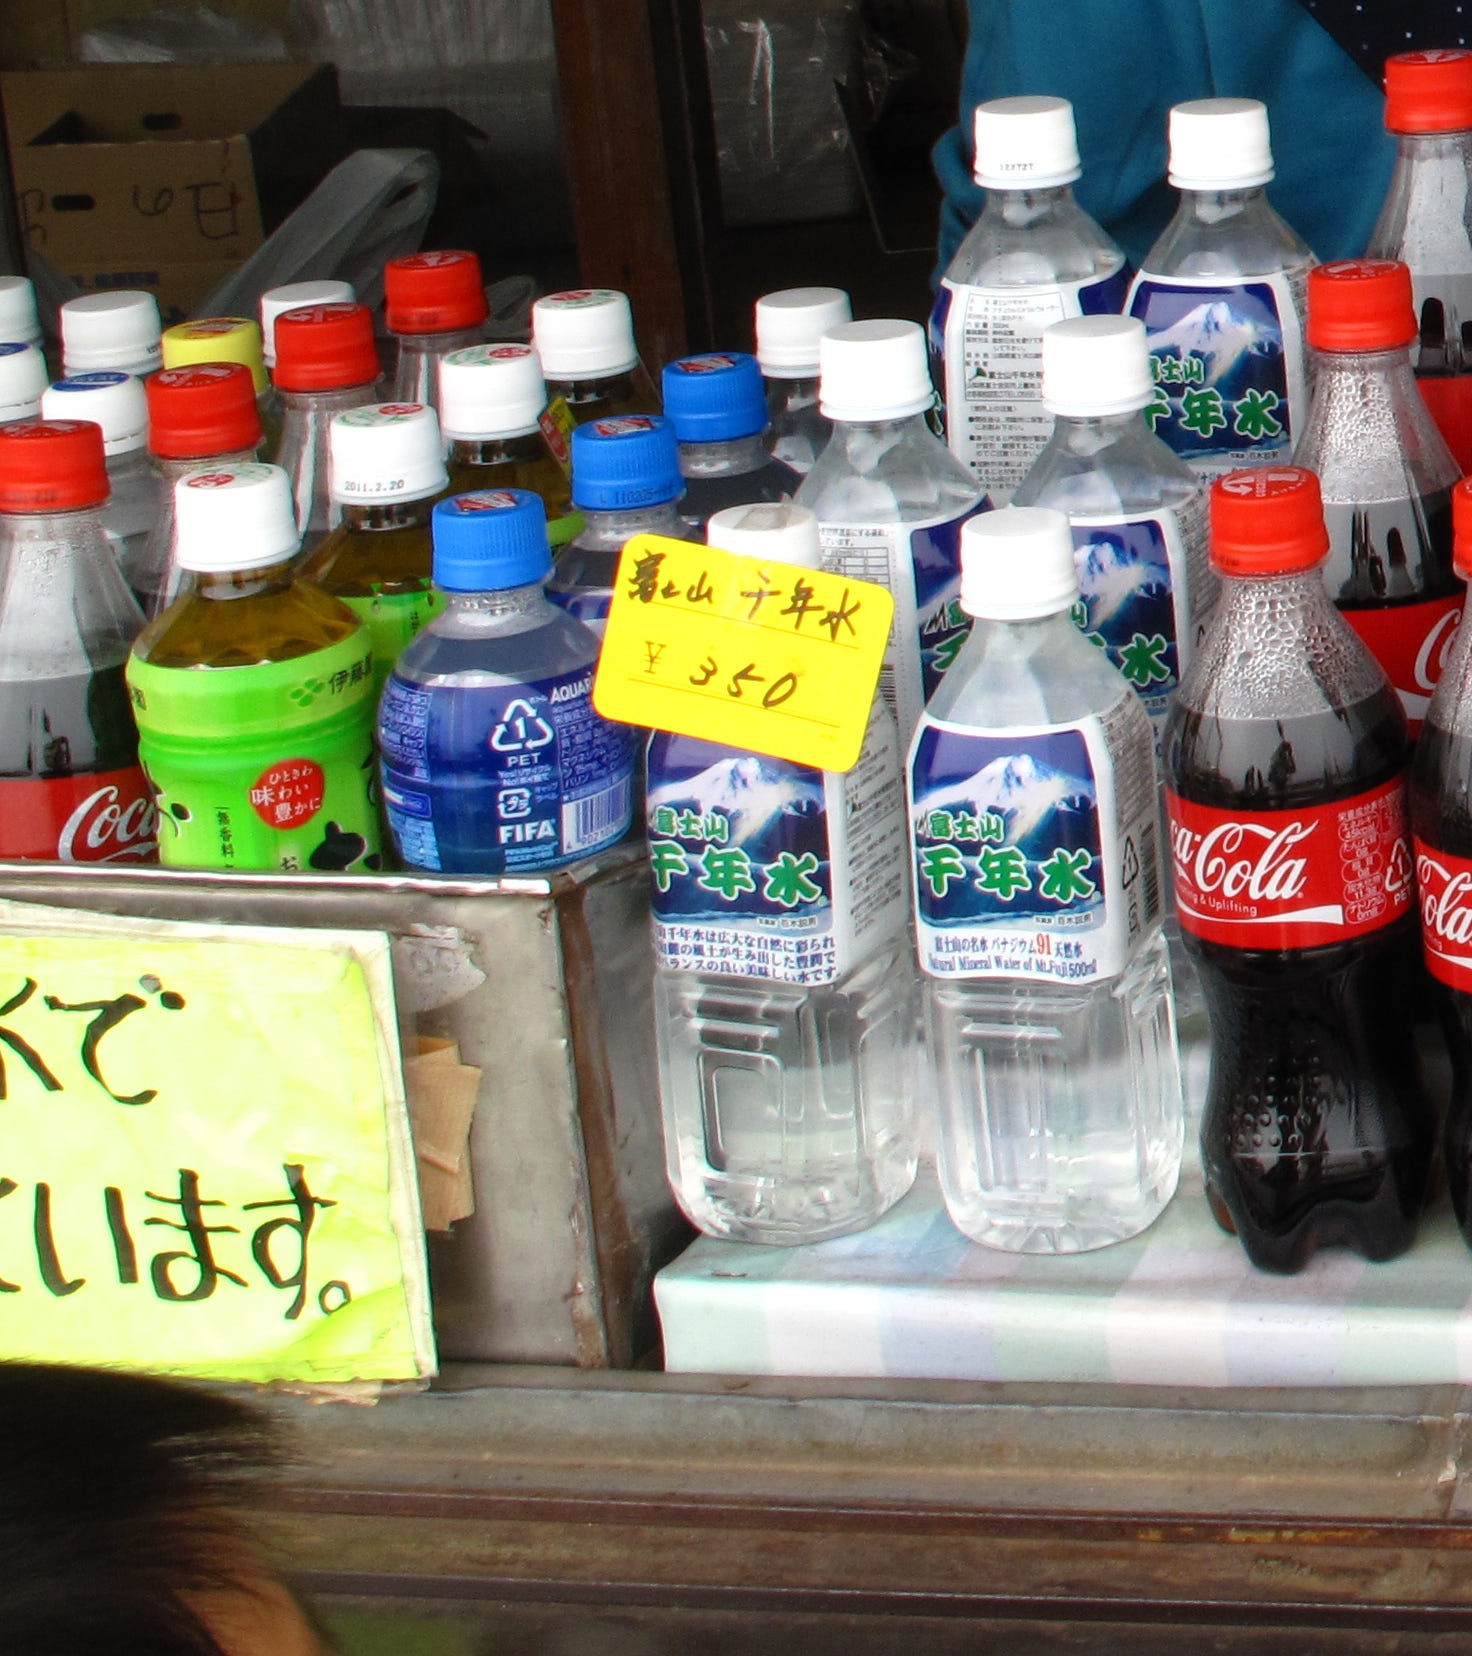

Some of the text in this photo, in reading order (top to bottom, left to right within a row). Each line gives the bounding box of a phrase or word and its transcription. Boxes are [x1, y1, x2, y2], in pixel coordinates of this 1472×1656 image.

[507, 752, 541, 767] PET
[269, 764, 313, 786] ひときわ
[251, 781, 309, 806] 味わい
[274, 796, 320, 824] 豊かに
[500, 821, 555, 844] FIFA
[656, 805, 729, 843] 富士山
[930, 810, 1004, 842] 富士山
[651, 841, 822, 907] 千年水
[922, 844, 1096, 903] 千年水
[959, 956, 991, 971] Mineral
